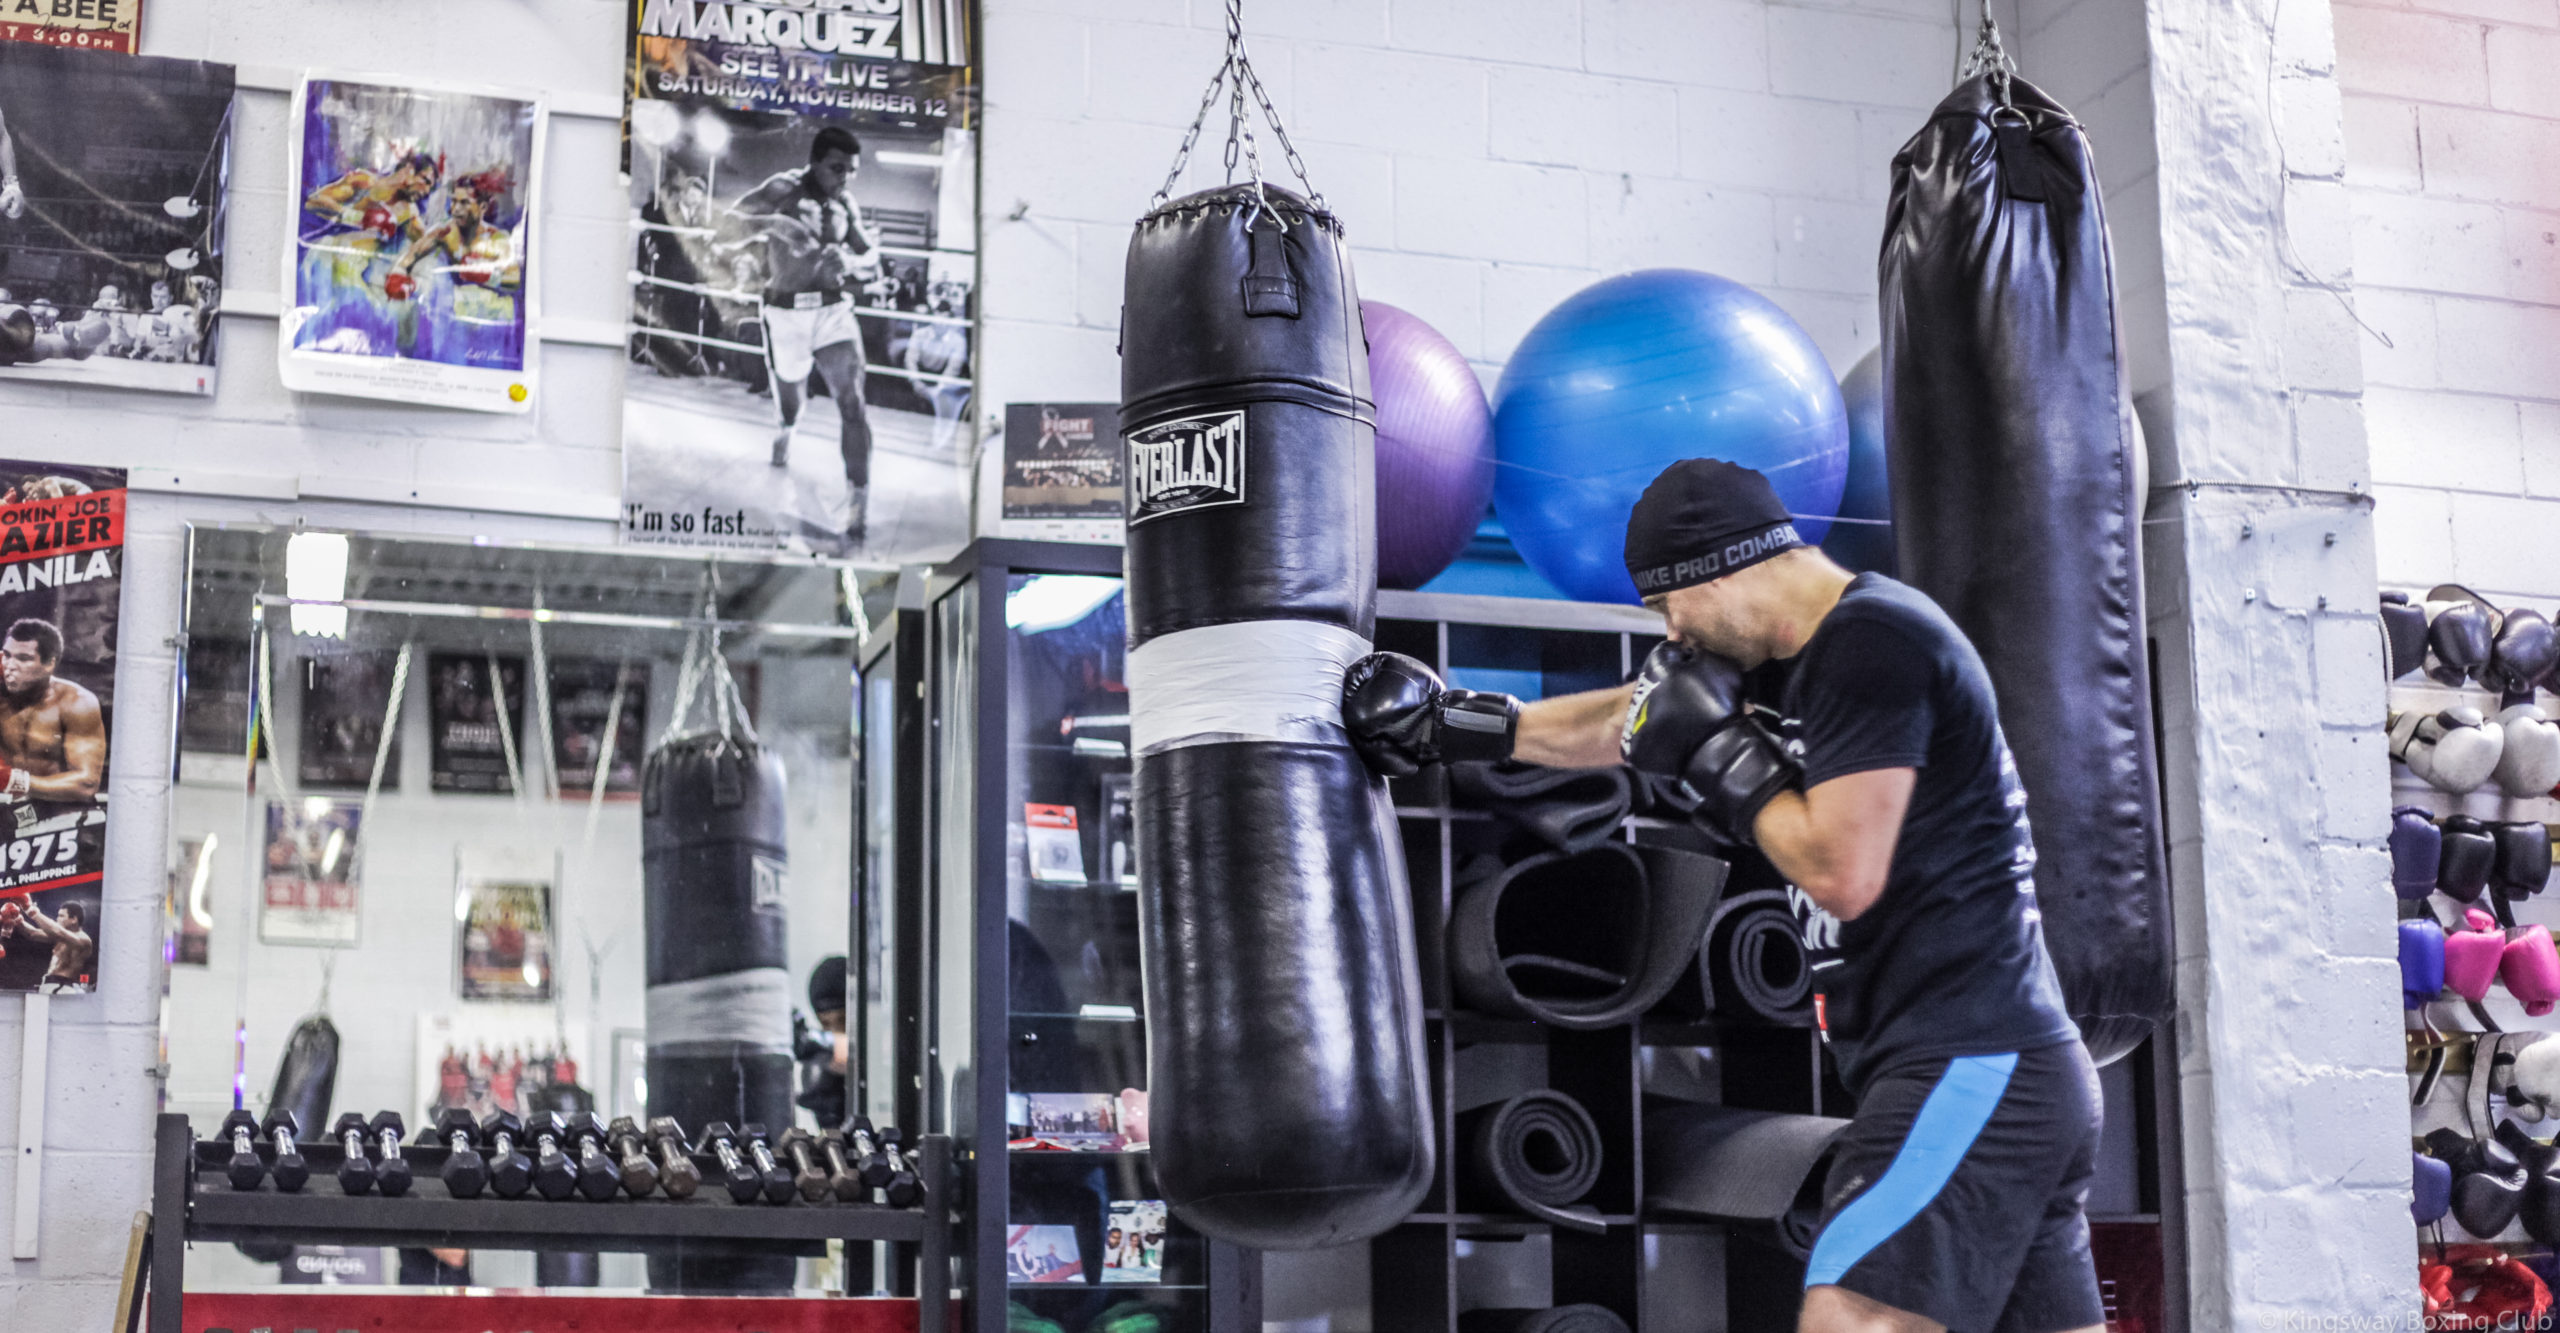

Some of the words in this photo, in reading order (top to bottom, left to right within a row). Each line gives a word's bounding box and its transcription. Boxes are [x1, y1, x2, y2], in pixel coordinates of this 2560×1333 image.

[14, 0, 39, 14] A
[51, 0, 118, 21] BEE
[640, 1, 898, 58] MARQUEZ
[720, 53, 779, 79] SEE
[787, 57, 814, 81] IT
[824, 60, 889, 89] LIVE
[658, 72, 784, 104] SATURDAY,
[789, 85, 916, 113] NOVEMBER
[924, 100, 948, 117] 12
[1129, 415, 1240, 516] EVERLAST
[69, 497, 110, 517] JOE
[671, 512, 694, 533] so
[703, 507, 745, 536] fast
[0, 516, 111, 557] AZIER
[1675, 552, 1720, 582] PRO
[1725, 525, 1801, 567] COMBA
[0, 829, 78, 872] 1975
[18, 864, 77, 884] PHILIPPINES
